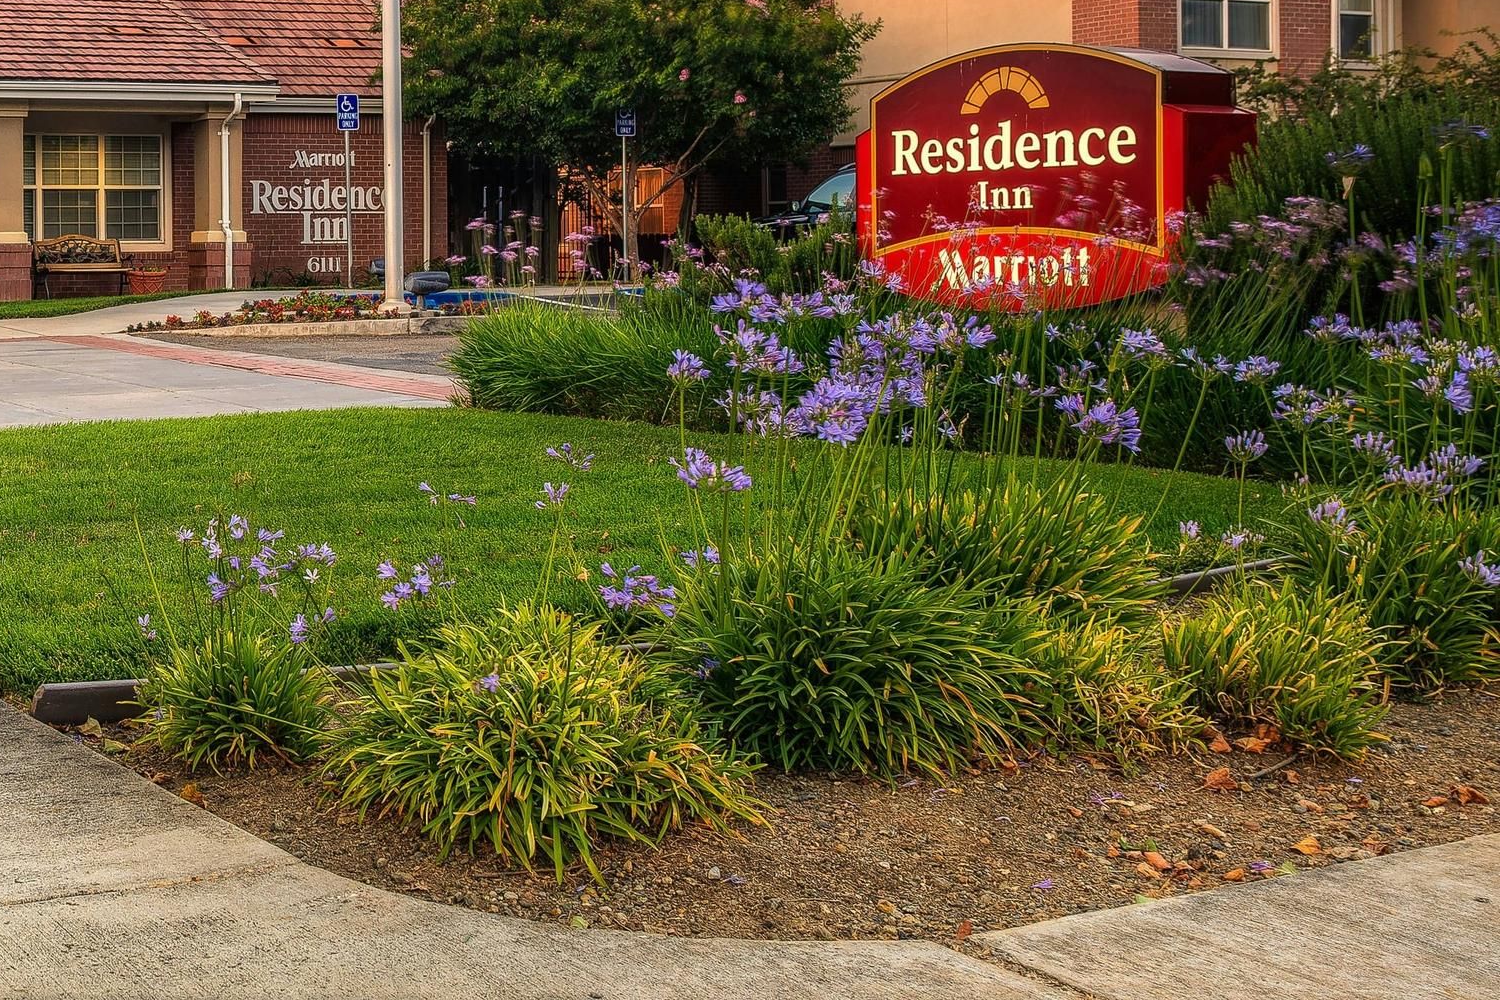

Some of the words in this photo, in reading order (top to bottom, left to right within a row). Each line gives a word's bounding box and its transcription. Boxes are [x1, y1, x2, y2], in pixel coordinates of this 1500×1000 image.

[341, 120, 355, 128] ONLY
[289, 150, 356, 169] Marriot
[890, 119, 1138, 176] Residence
[977, 180, 1034, 211] Inn
[306, 257, 342, 273] 6111
[930, 246, 1092, 291] Marriott
